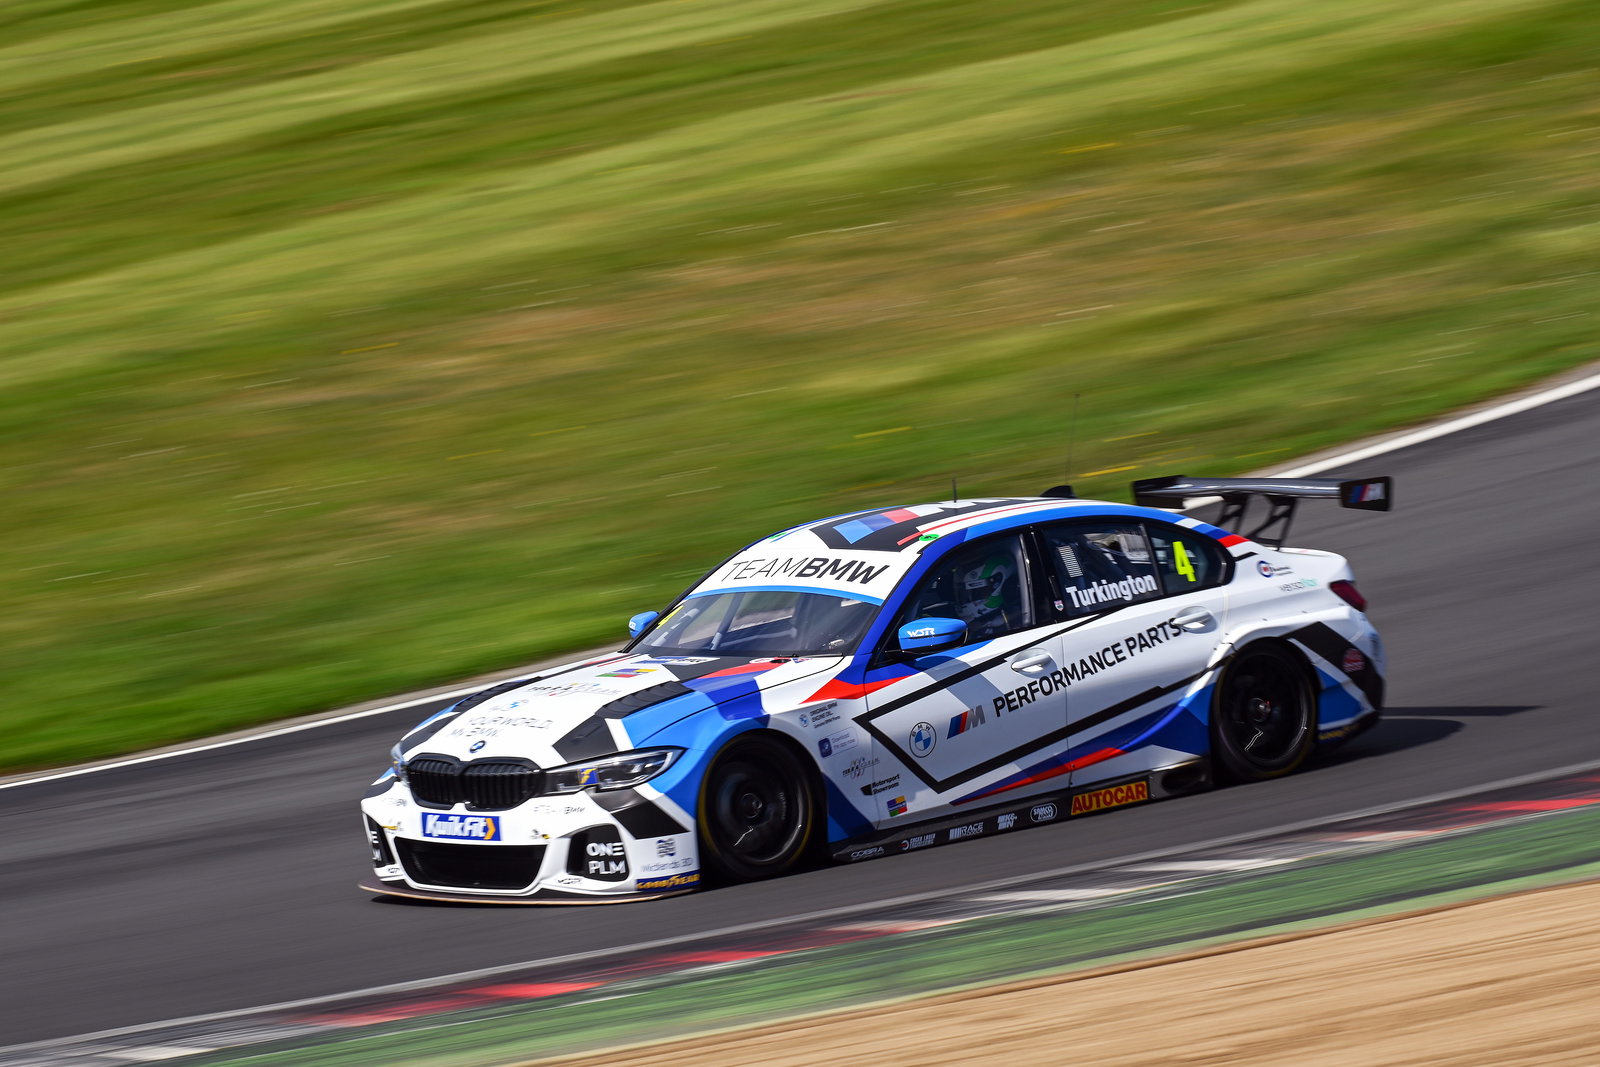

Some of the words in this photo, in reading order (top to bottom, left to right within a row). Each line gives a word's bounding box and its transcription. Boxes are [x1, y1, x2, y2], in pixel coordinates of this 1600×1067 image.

[1172, 541, 1197, 582] 4
[1065, 574, 1158, 608] Turkington
[992, 642, 1127, 718] PERFORMANCE
[1072, 782, 1147, 814] AUTOCAR
[586, 842, 624, 857] ONE
[588, 860, 627, 875] PLM
